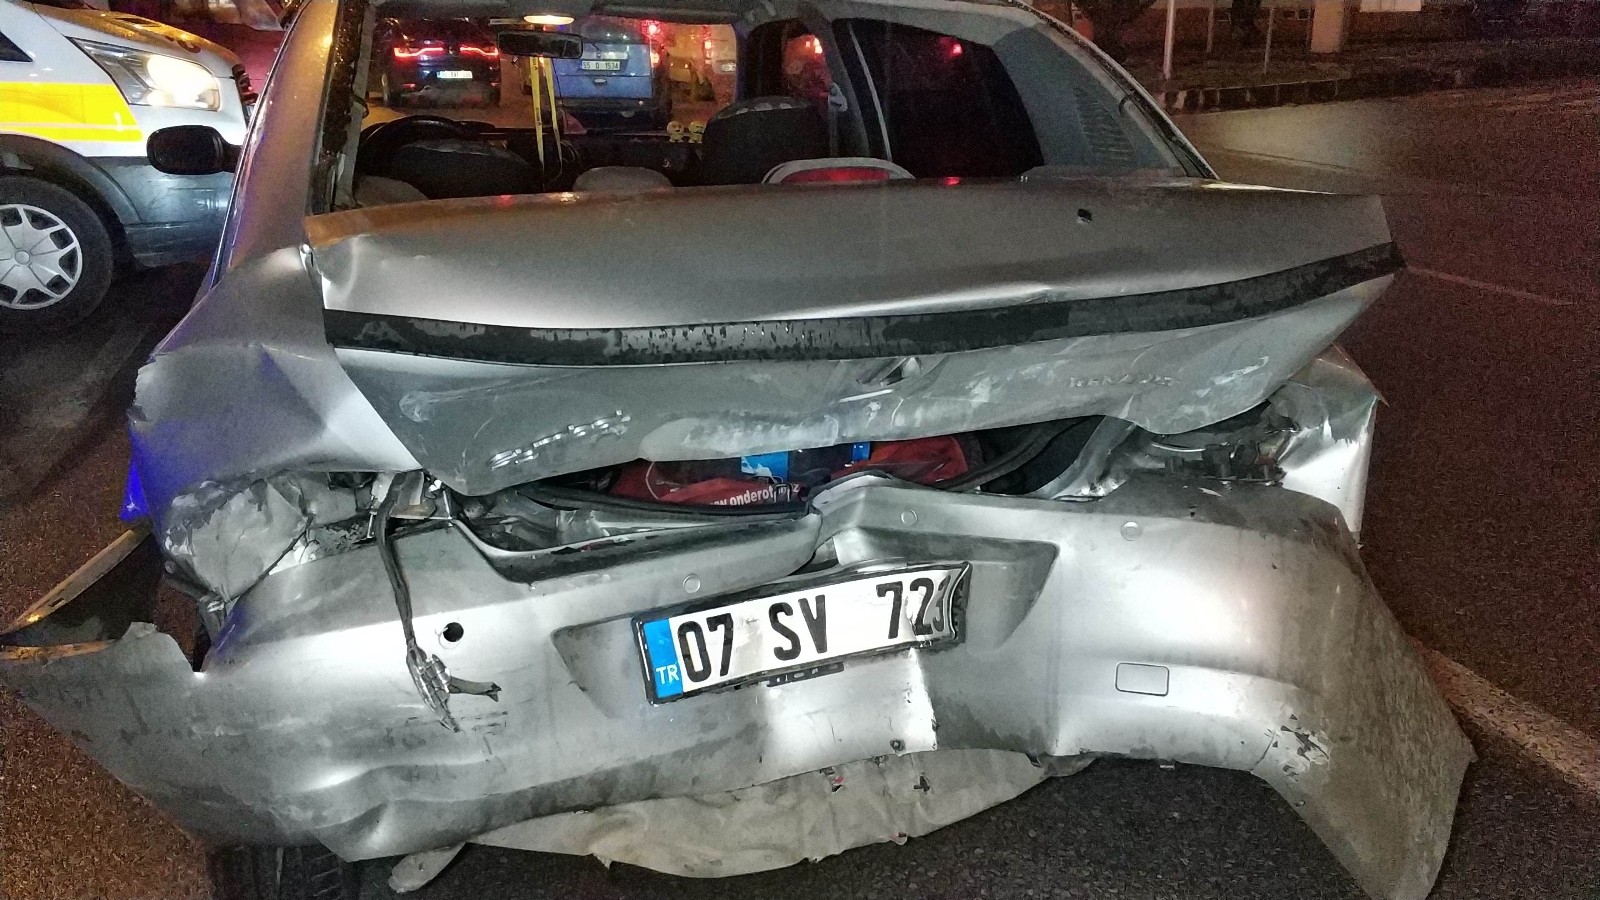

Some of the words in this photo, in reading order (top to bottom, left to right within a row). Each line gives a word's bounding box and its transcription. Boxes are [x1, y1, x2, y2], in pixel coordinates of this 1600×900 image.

[677, 612, 734, 683] 07
[768, 594, 828, 661] SV
[876, 574, 951, 639] 723
[655, 663, 680, 685] TR
